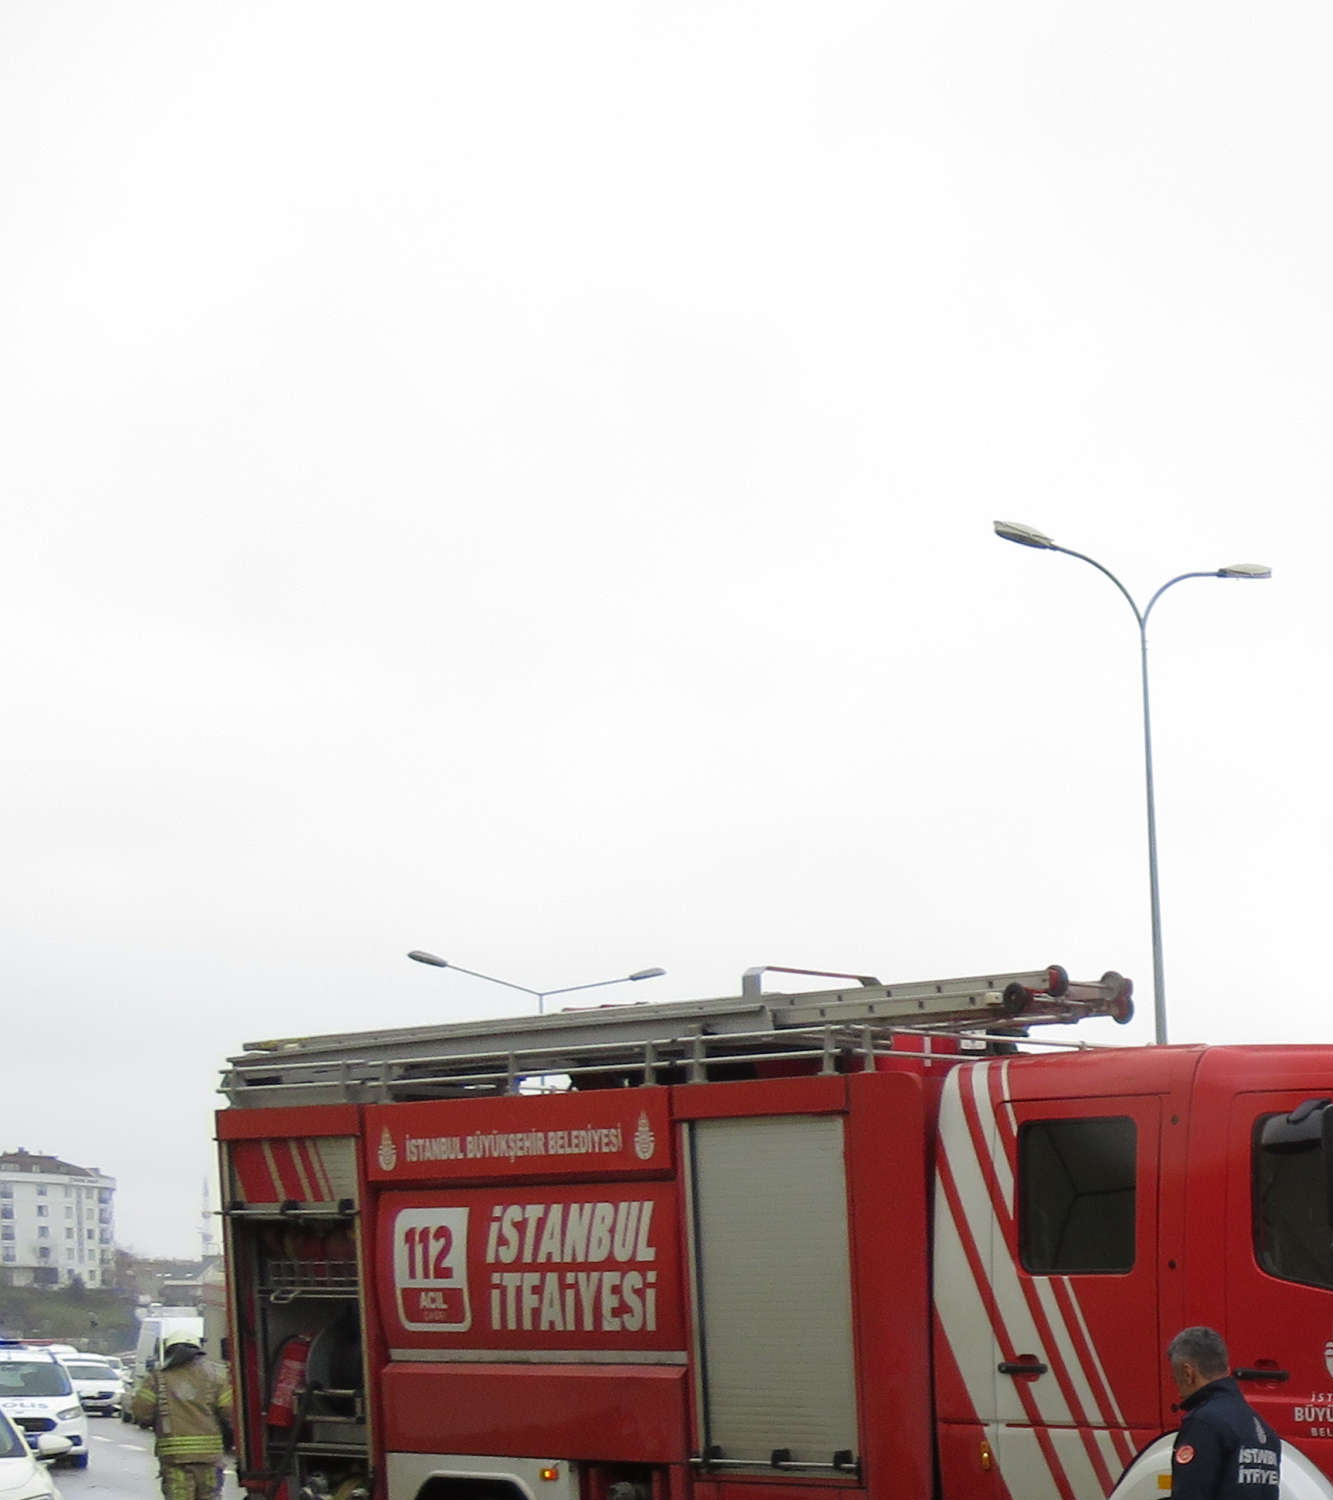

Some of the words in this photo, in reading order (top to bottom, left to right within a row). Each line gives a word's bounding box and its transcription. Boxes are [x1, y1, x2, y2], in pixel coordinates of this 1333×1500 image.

[405, 1134, 464, 1162] İSTANBUL
[465, 1129, 546, 1163] BÜYÜKŞEHİR
[547, 1122, 622, 1154] BELEDİYESİ
[404, 1224, 454, 1280] 112
